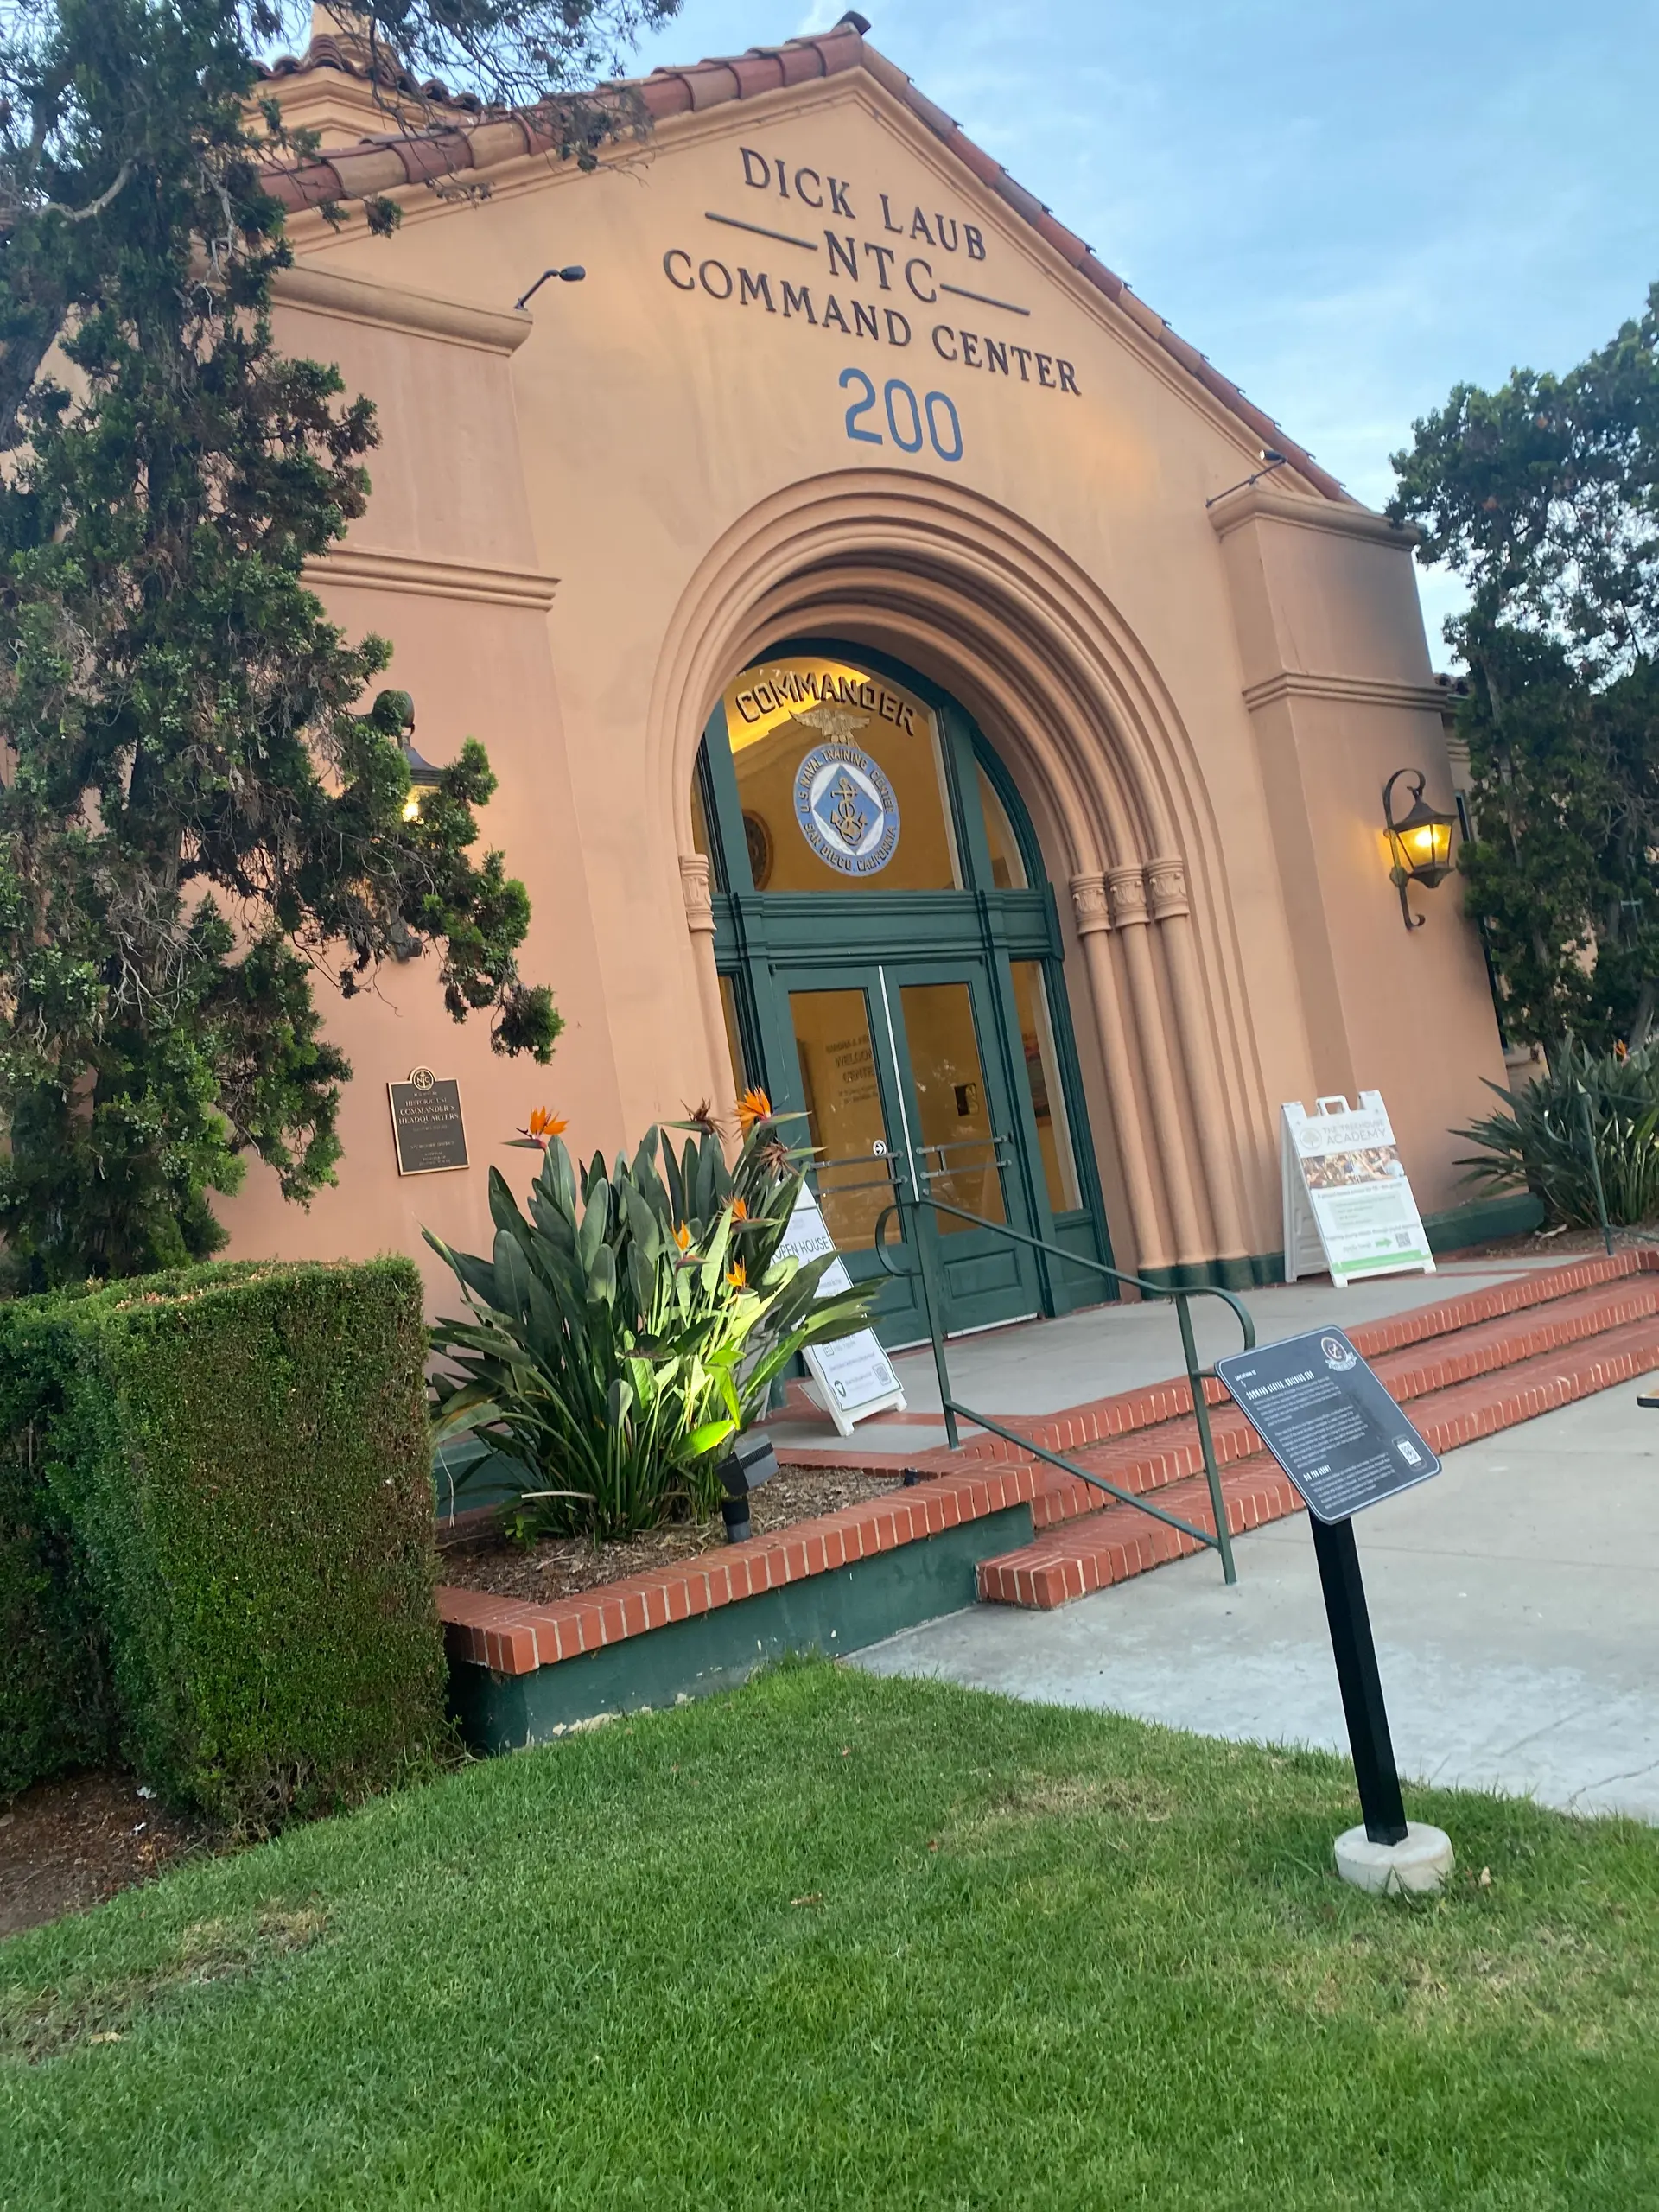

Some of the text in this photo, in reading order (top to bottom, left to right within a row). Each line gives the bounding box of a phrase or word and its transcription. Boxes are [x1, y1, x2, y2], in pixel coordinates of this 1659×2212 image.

[740, 146, 987, 261] DICK LAUB
[823, 229, 938, 303] NTC
[662, 249, 1082, 396] COMMAND CENTER
[838, 367, 963, 462] 200
[735, 671, 916, 737] COMMANDER
[799, 755, 823, 790] NAVAL
[822, 748, 868, 771] TRAINING
[398, 1112, 459, 1125] HEADQUARTERS
[1326, 1126, 1386, 1146] ACADEMY
[798, 1236, 830, 1255] HOUSE
